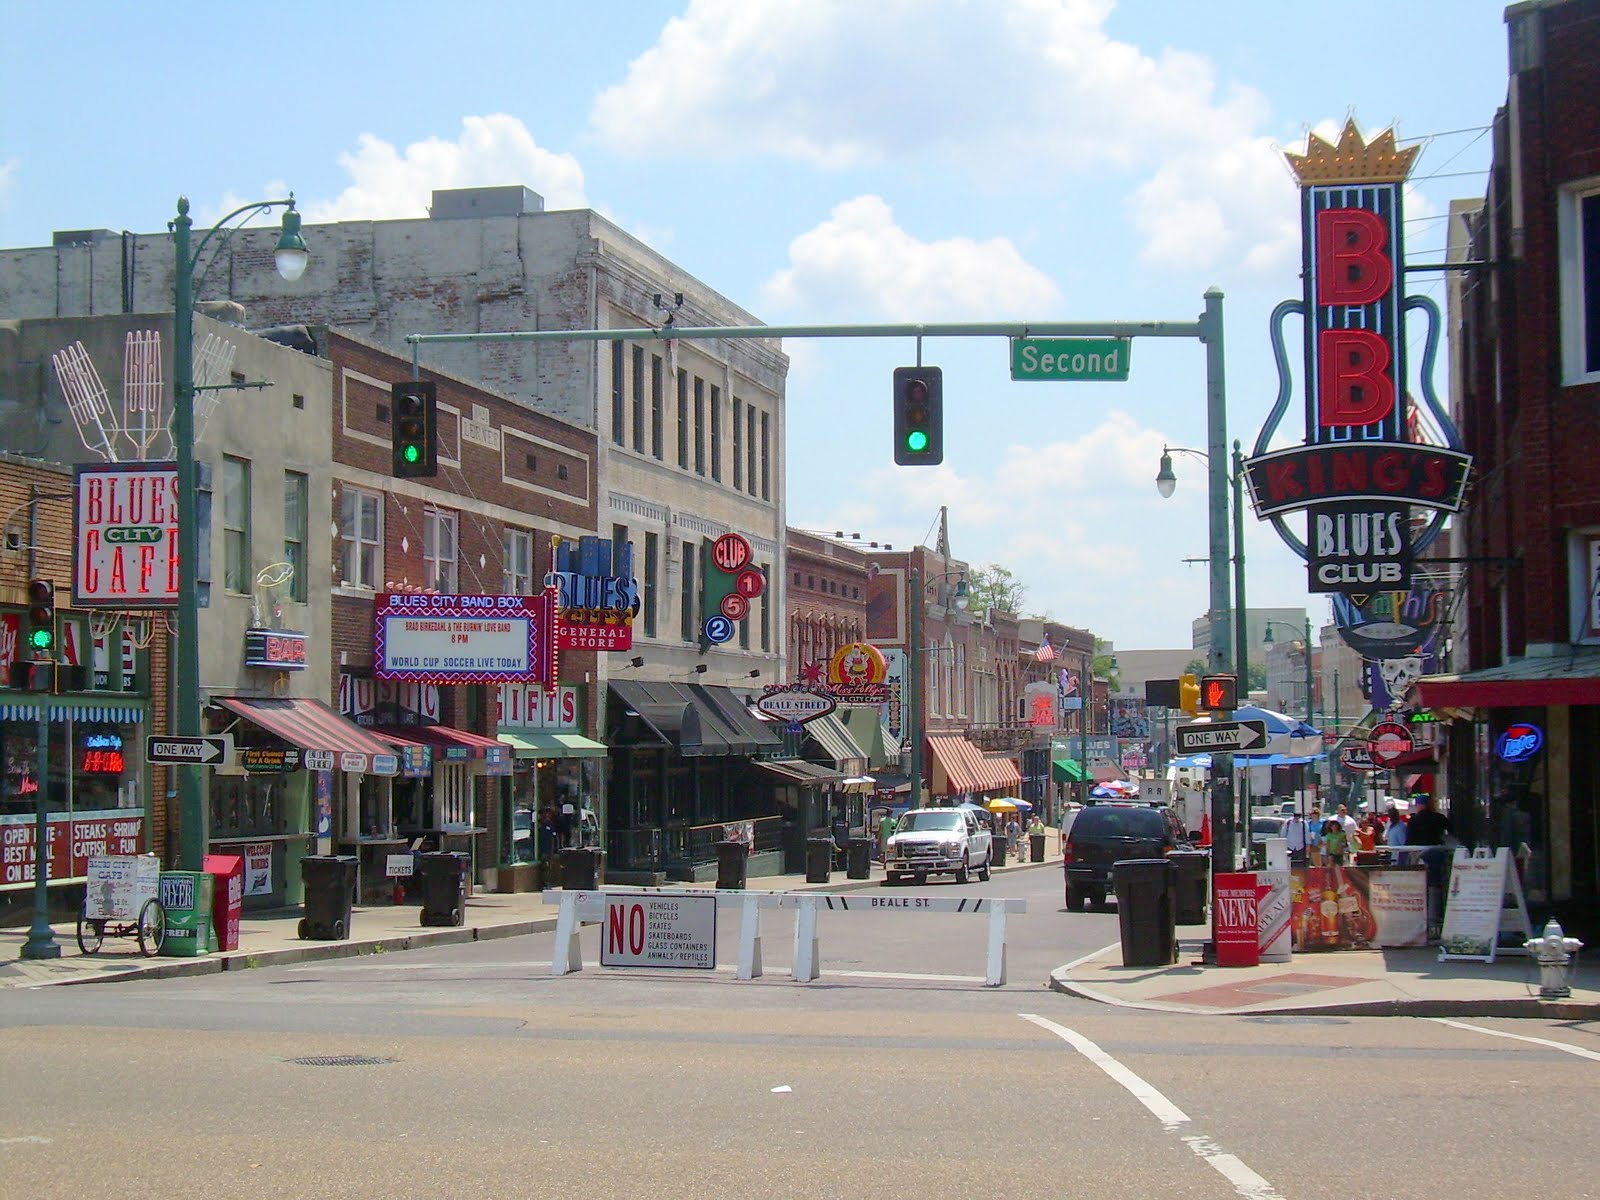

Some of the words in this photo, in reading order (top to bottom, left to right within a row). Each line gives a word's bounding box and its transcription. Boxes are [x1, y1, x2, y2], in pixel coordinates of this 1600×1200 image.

[1021, 345, 1119, 374] Second
[463, 421, 498, 447] LERNER
[1265, 451, 1447, 502] KING'S
[86, 477, 179, 525] BLUES
[107, 528, 159, 542] CITY
[1316, 512, 1403, 558] BLUES
[85, 528, 179, 593] CAFE
[715, 540, 746, 568] CLUB
[1317, 562, 1403, 585] CLUB
[743, 576, 753, 592] 1
[390, 595, 427, 606] BLUES
[431, 596, 457, 607] CITY
[461, 596, 494, 608] BAND
[498, 597, 523, 608] BOX
[553, 573, 629, 614] BLUES
[727, 599, 740, 615] 5
[565, 608, 631, 627] CITY
[406, 621, 418, 631] BRAD
[453, 622, 462, 632] THE
[484, 622, 496, 632] LOVE
[498, 622, 510, 633] BAND
[560, 626, 625, 638] GENERAL
[711, 621, 725, 638] 2
[451, 634, 456, 644] 8
[457, 634, 468, 644] PM
[571, 637, 615, 648] STORE
[267, 637, 305, 662] BAR
[391, 656, 419, 667] WORLD
[424, 657, 440, 668] CUP
[444, 657, 475, 668] SOCCER
[477, 657, 495, 668] LIVE
[497, 657, 522, 669] TODAY
[763, 701, 791, 709] BEALE
[794, 701, 827, 709] STREET
[1187, 732, 1211, 745] ONE
[1215, 730, 1239, 743] WAY
[1504, 734, 1537, 757] Lite
[156, 744, 179, 755] ONE
[181, 745, 203, 756] WAY
[309, 751, 331, 759] COLD
[309, 761, 331, 769] BEER
[4, 830, 30, 845] OPEN
[74, 824, 107, 840] STEAKS
[114, 821, 141, 837] SHRIMP
[4, 846, 28, 863] BEST
[73, 841, 107, 858] CATFISH
[120, 839, 136, 853] FUN
[7, 865, 21, 881] ON
[24, 863, 53, 881] BEE
[388, 866, 412, 875] TICKETS
[162, 884, 192, 906] FLYER
[871, 898, 909, 907] BEALE
[915, 898, 930, 907] ST.
[649, 912, 679, 920] BICYCLES
[1217, 898, 1257, 927] NEWS
[609, 904, 645, 956] NO
[649, 902, 679, 911] VEHICLES
[649, 922, 671, 930] SKATES
[648, 932, 692, 941] SKATEBOARDS
[648, 941, 668, 950] GLASS
[670, 942, 708, 952] CONTAINERS
[648, 952, 708, 961] ANIMALS/REPTILES
